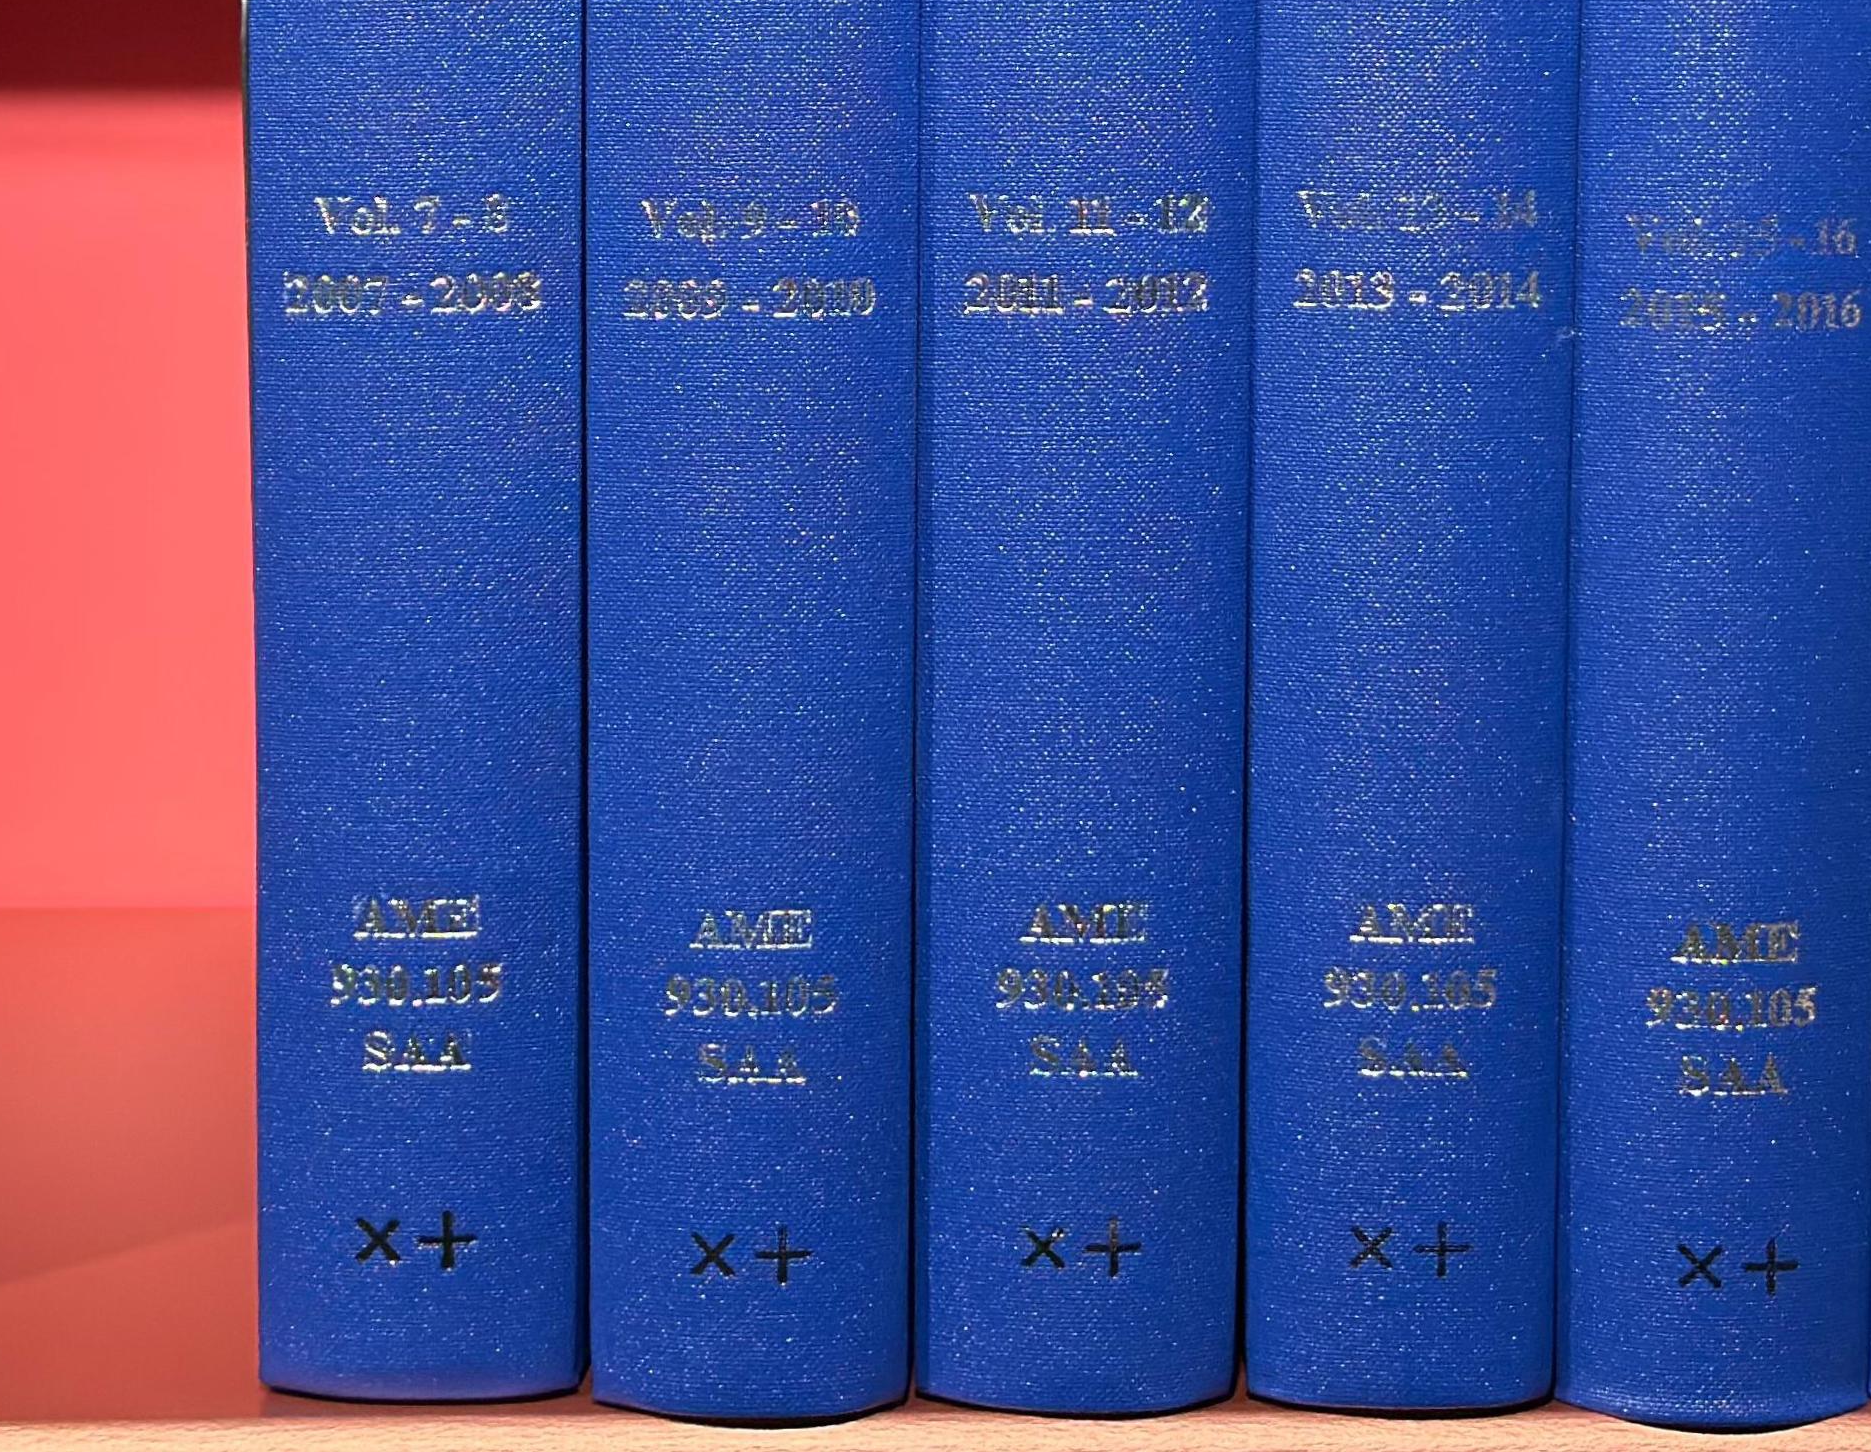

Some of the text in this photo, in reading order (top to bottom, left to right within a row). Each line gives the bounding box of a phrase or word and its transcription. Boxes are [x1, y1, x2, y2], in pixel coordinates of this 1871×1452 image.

[313, 195, 401, 236] Vol.
[412, 196, 441, 235] 7
[1068, 195, 1115, 236] 11
[1813, 217, 1859, 257] 16
[283, 273, 390, 315] 2007
[964, 273, 1065, 315] 2011
[1103, 273, 1209, 315] 2012
[1292, 268, 1396, 311] 2013
[1439, 269, 1543, 314] 2014
[1771, 289, 1864, 331] 2016
[353, 895, 480, 939] AME
[689, 908, 813, 950] AME
[1019, 901, 1148, 944] AME
[1349, 903, 1476, 944] AME
[1671, 920, 1800, 964] AME
[330, 962, 503, 1007] 930.105
[664, 974, 839, 1018] 930.105
[1324, 968, 1498, 1012] 930.105
[1646, 985, 1819, 1032] 930.105
[362, 1030, 472, 1072] SAA
[696, 1042, 807, 1085] SAA
[1029, 1036, 1138, 1078] SAA
[1356, 1036, 1469, 1078] SAA
[1679, 1052, 1789, 1097] SAA
